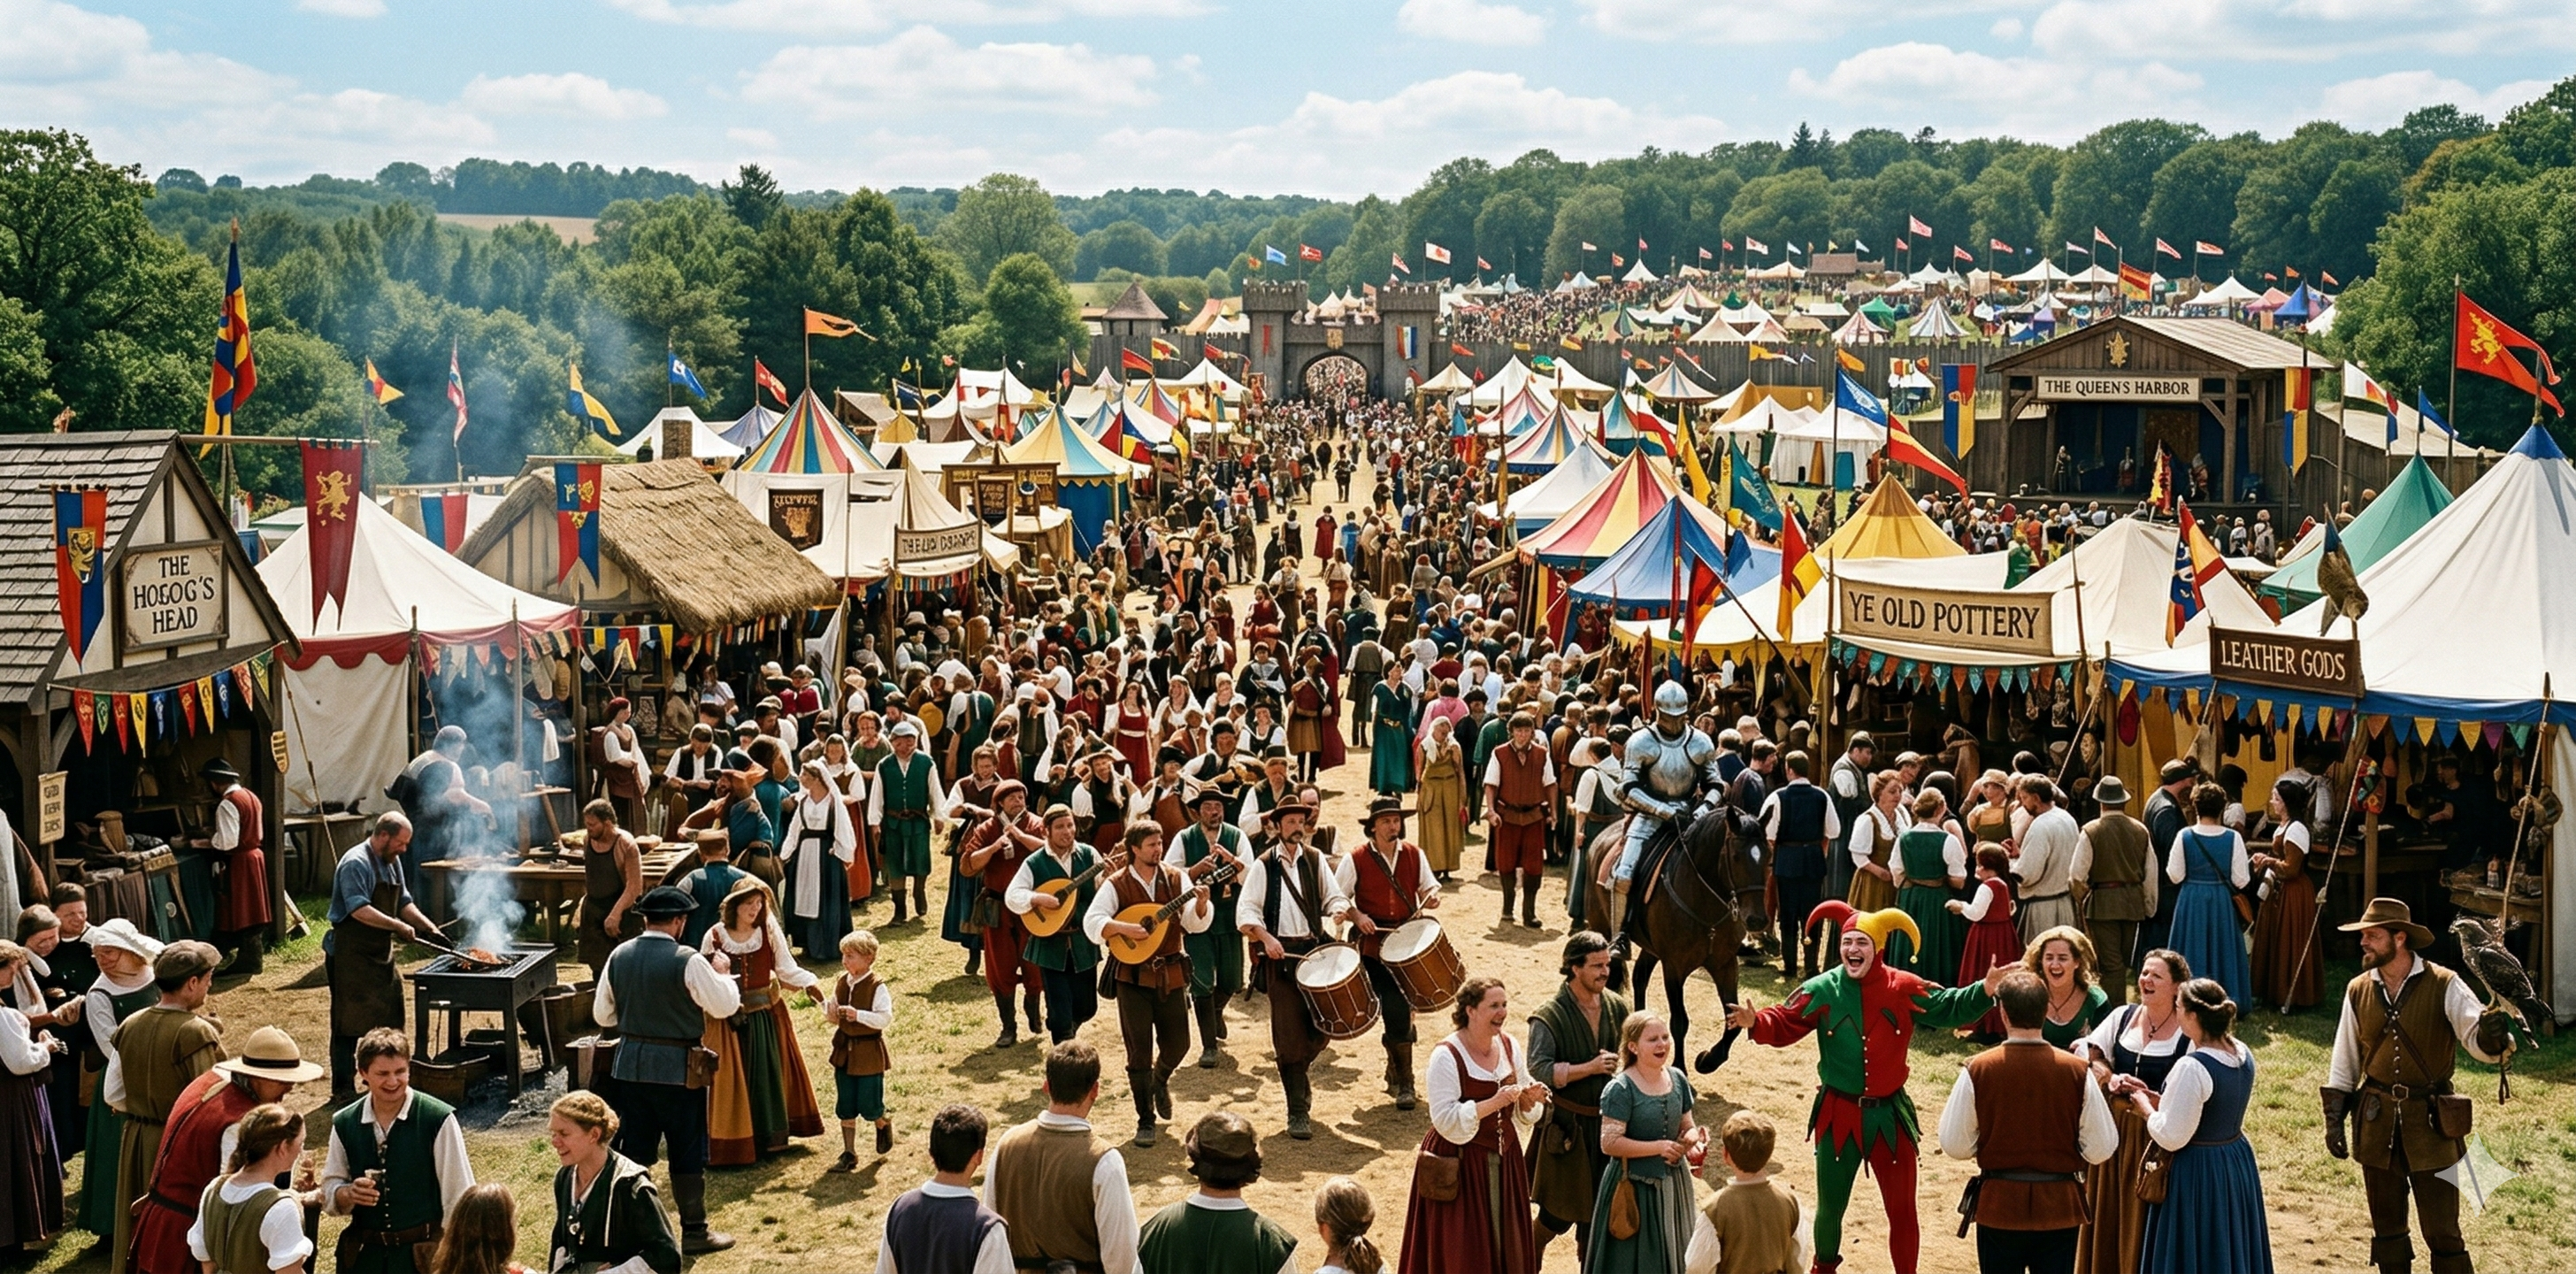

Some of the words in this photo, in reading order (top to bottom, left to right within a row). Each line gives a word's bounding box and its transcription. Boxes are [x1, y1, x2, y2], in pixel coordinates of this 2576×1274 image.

[2044, 380, 2071, 393] THE
[2075, 380, 2130, 396] QUEENS
[2135, 381, 2190, 395] HARBOR
[158, 555, 190, 578] THE
[152, 606, 198, 634] HEAD
[1849, 591, 1874, 622] YE
[1882, 597, 1925, 629] OLD
[1933, 602, 2040, 639] POTTERY
[2220, 641, 2296, 674] LEATHER
[2301, 649, 2345, 680] GODS
